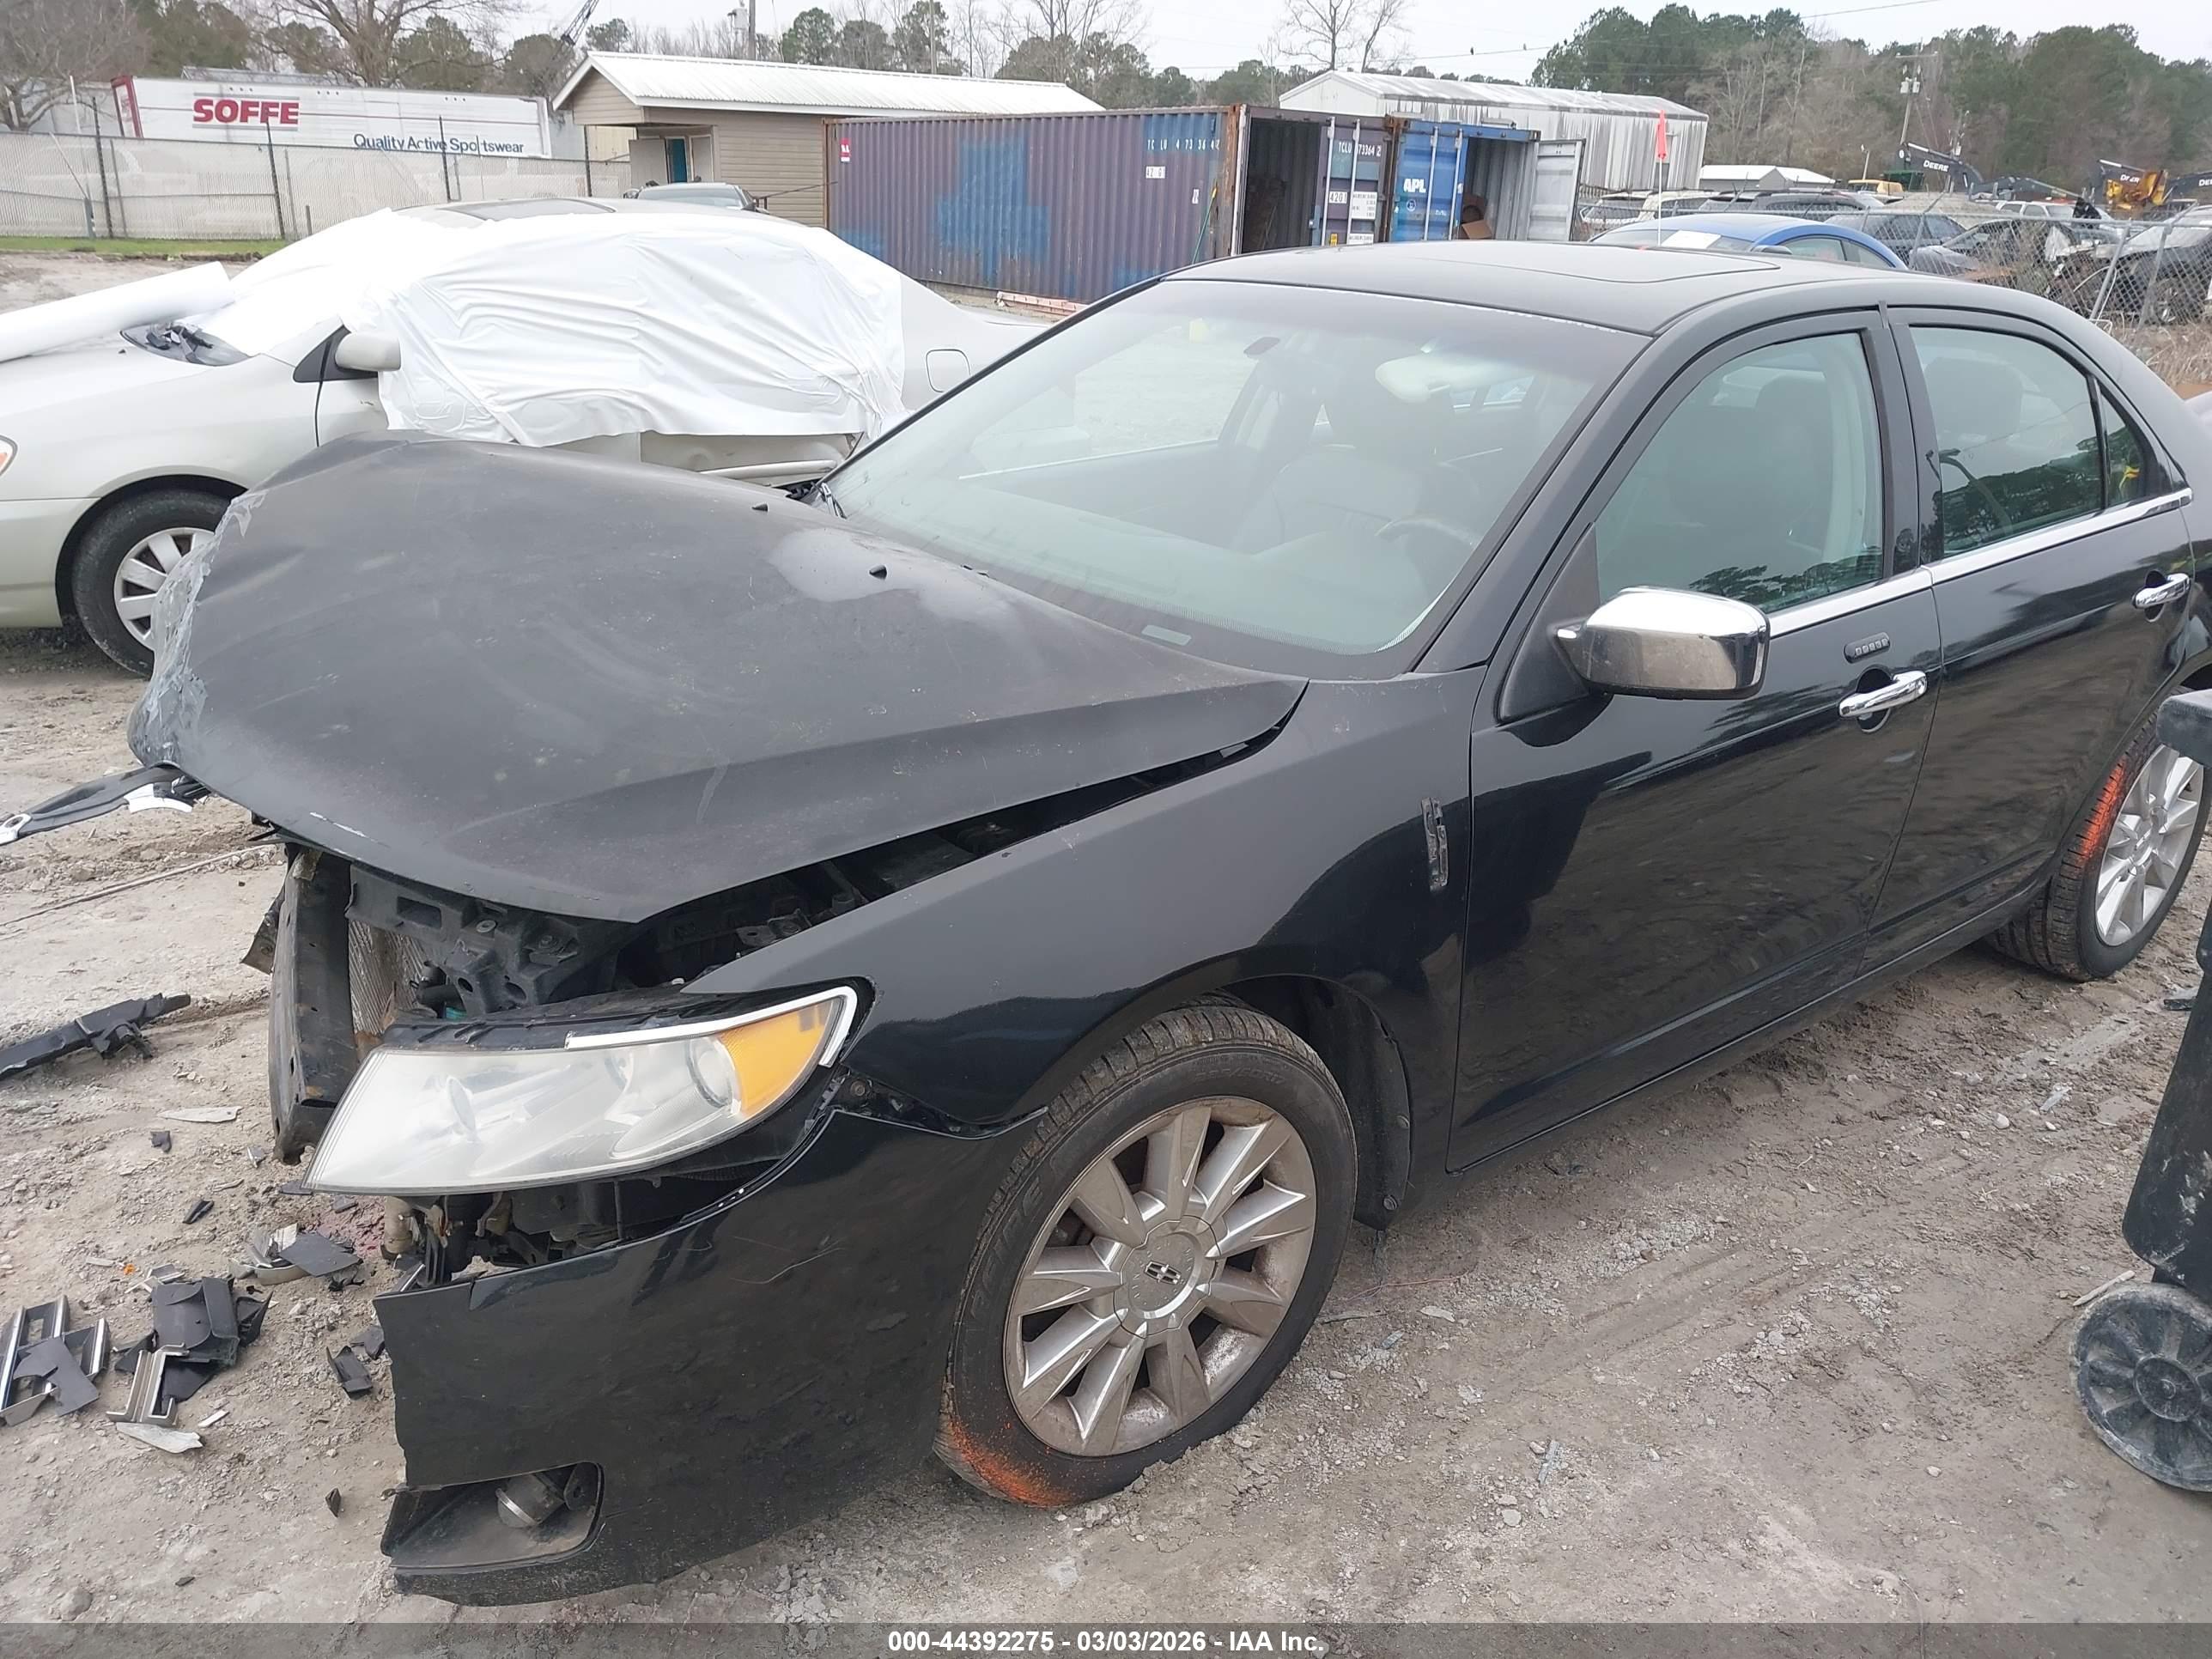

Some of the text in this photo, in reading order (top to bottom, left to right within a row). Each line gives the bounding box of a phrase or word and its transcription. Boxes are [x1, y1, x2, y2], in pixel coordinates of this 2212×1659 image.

[193, 99, 299, 125] SOFFE
[354, 133, 524, 154] Quality Active Spotswear
[1923, 160, 1949, 173] DEERE
[1403, 178, 1426, 193] APL
